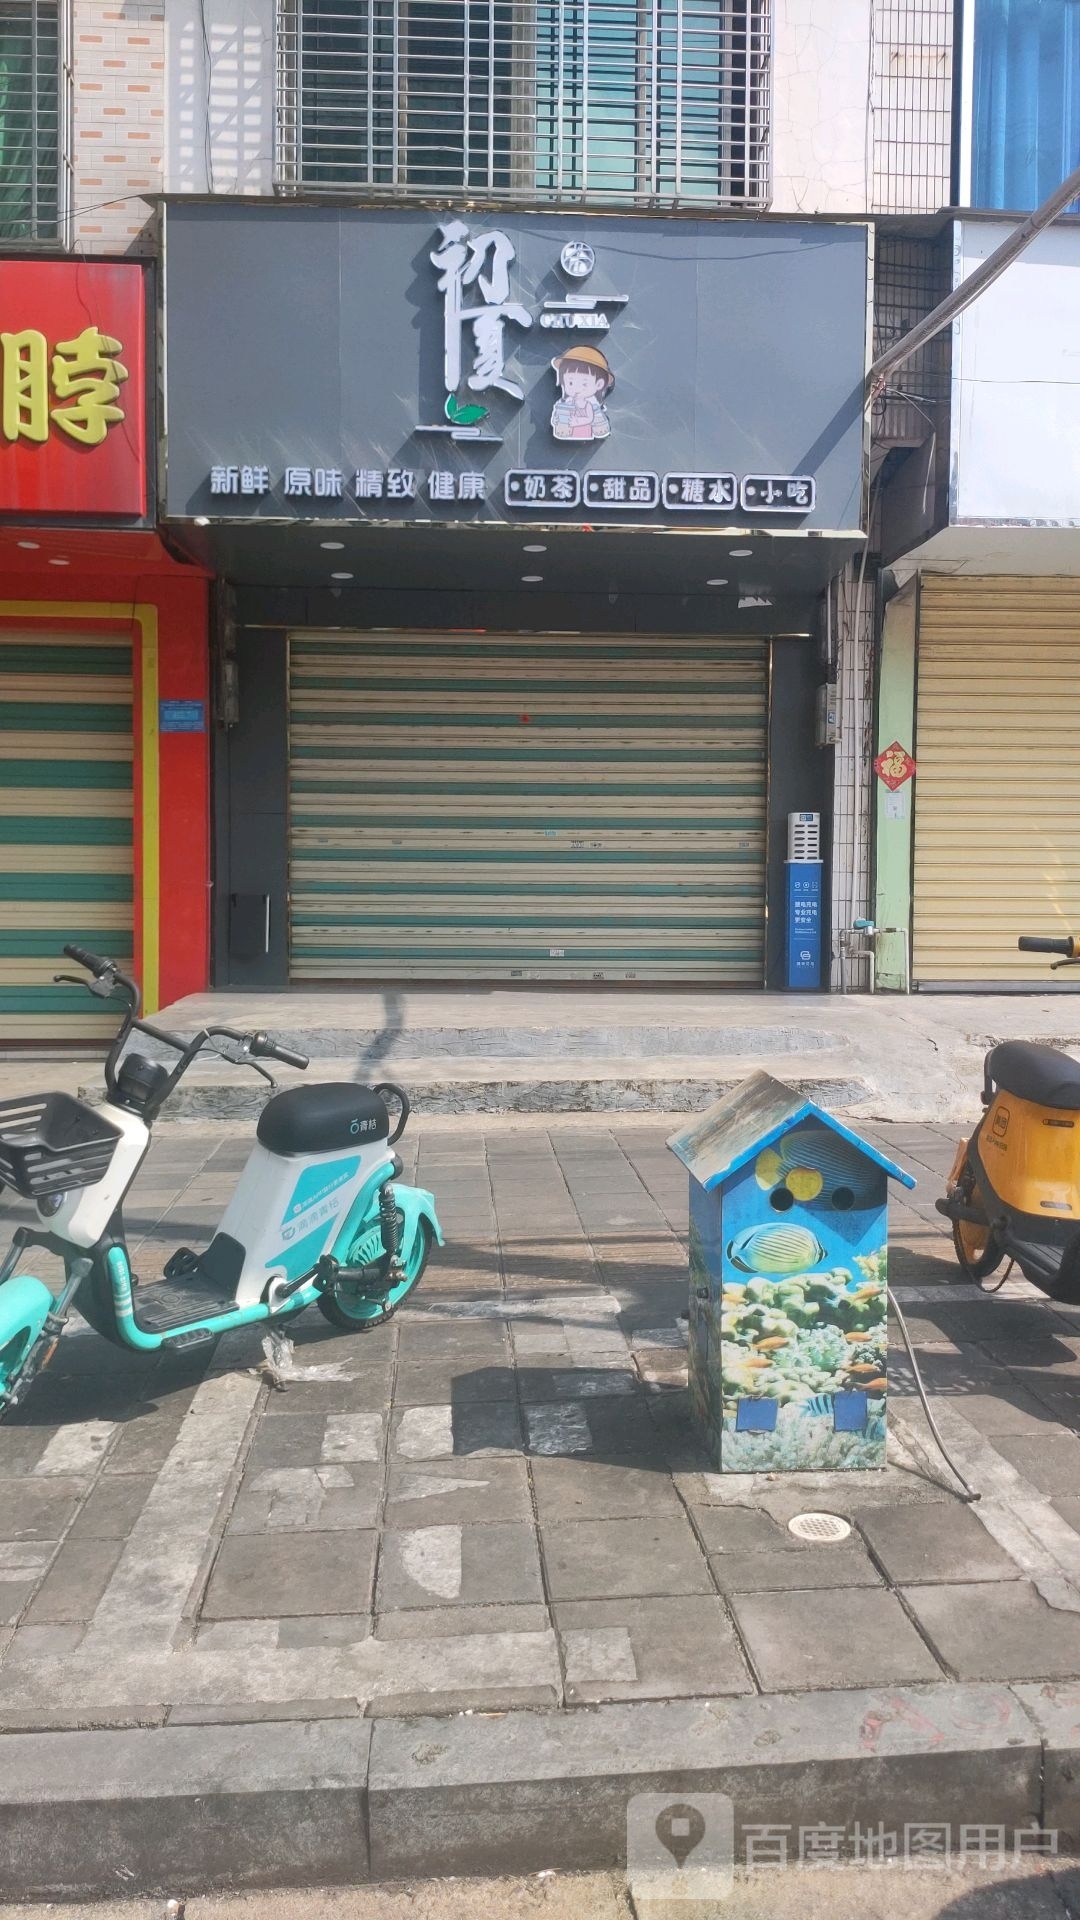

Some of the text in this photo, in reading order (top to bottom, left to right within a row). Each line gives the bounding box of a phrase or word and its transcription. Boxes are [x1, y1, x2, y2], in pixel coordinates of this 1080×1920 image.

[430, 220, 533, 400] 初夏
[0, 326, 129, 445] 脖
[210, 465, 486, 500] 新鲜 原味 精致 健康
[523, 475, 574, 499] 奶茶
[602, 477, 651, 501] 甜品
[681, 479, 732, 503] 糖水
[760, 481, 809, 504] 小吃
[881, 750, 908, 778] 福
